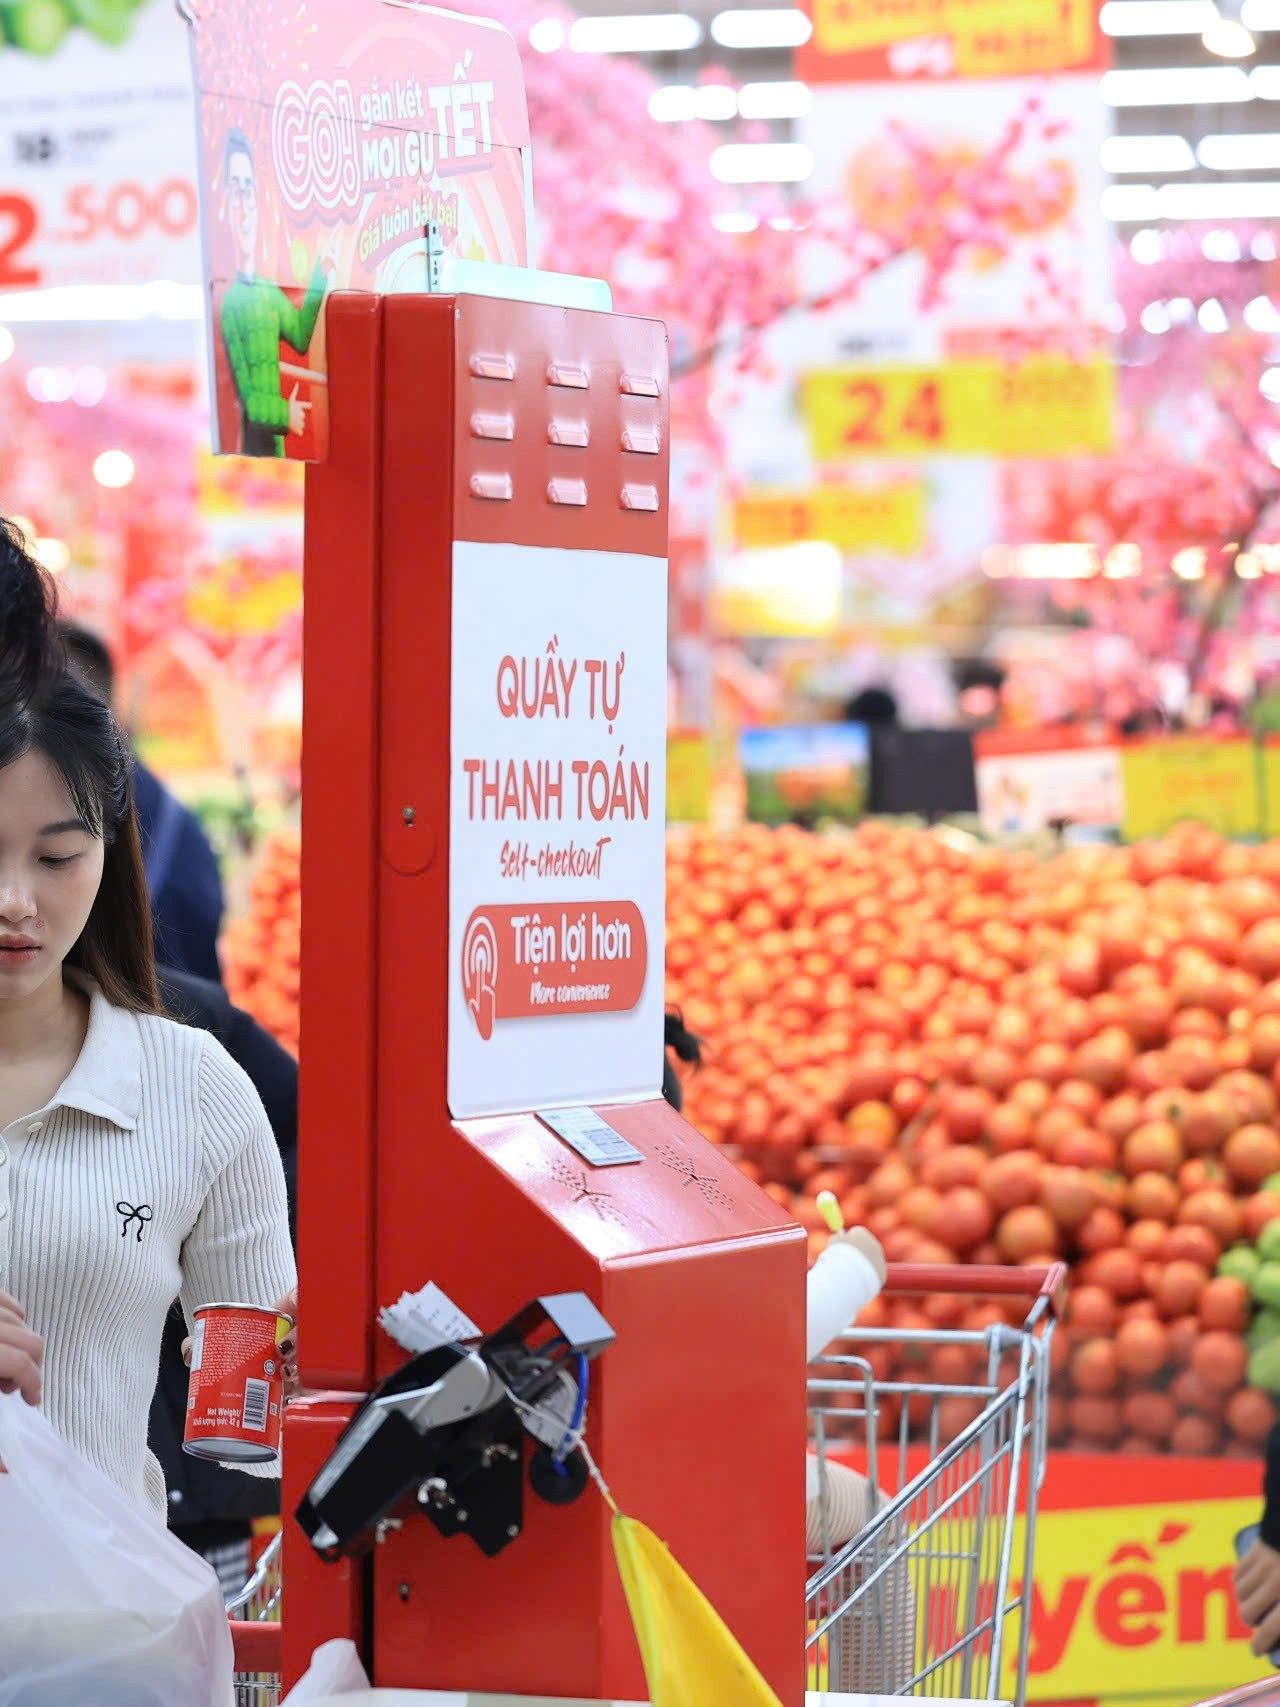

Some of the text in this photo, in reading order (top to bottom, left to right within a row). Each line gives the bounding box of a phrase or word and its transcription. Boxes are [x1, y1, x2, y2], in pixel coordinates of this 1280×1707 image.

[272, 80, 360, 211] GO!
[360, 75, 392, 132] gắn
[396, 72, 424, 119] kết
[428, 48, 495, 160] TẾT
[361, 136, 401, 190] MỌI
[360, 216, 381, 262] Giá
[382, 202, 410, 244] luôn
[842, 374, 945, 447] 24
[496, 633, 626, 736] QUẦY TỰ
[462, 743, 650, 822] THANH TOÁN
[500, 836, 613, 881] Self-checkout
[510, 911, 632, 976] Tiện lợi hơn
[530, 981, 556, 1004] More
